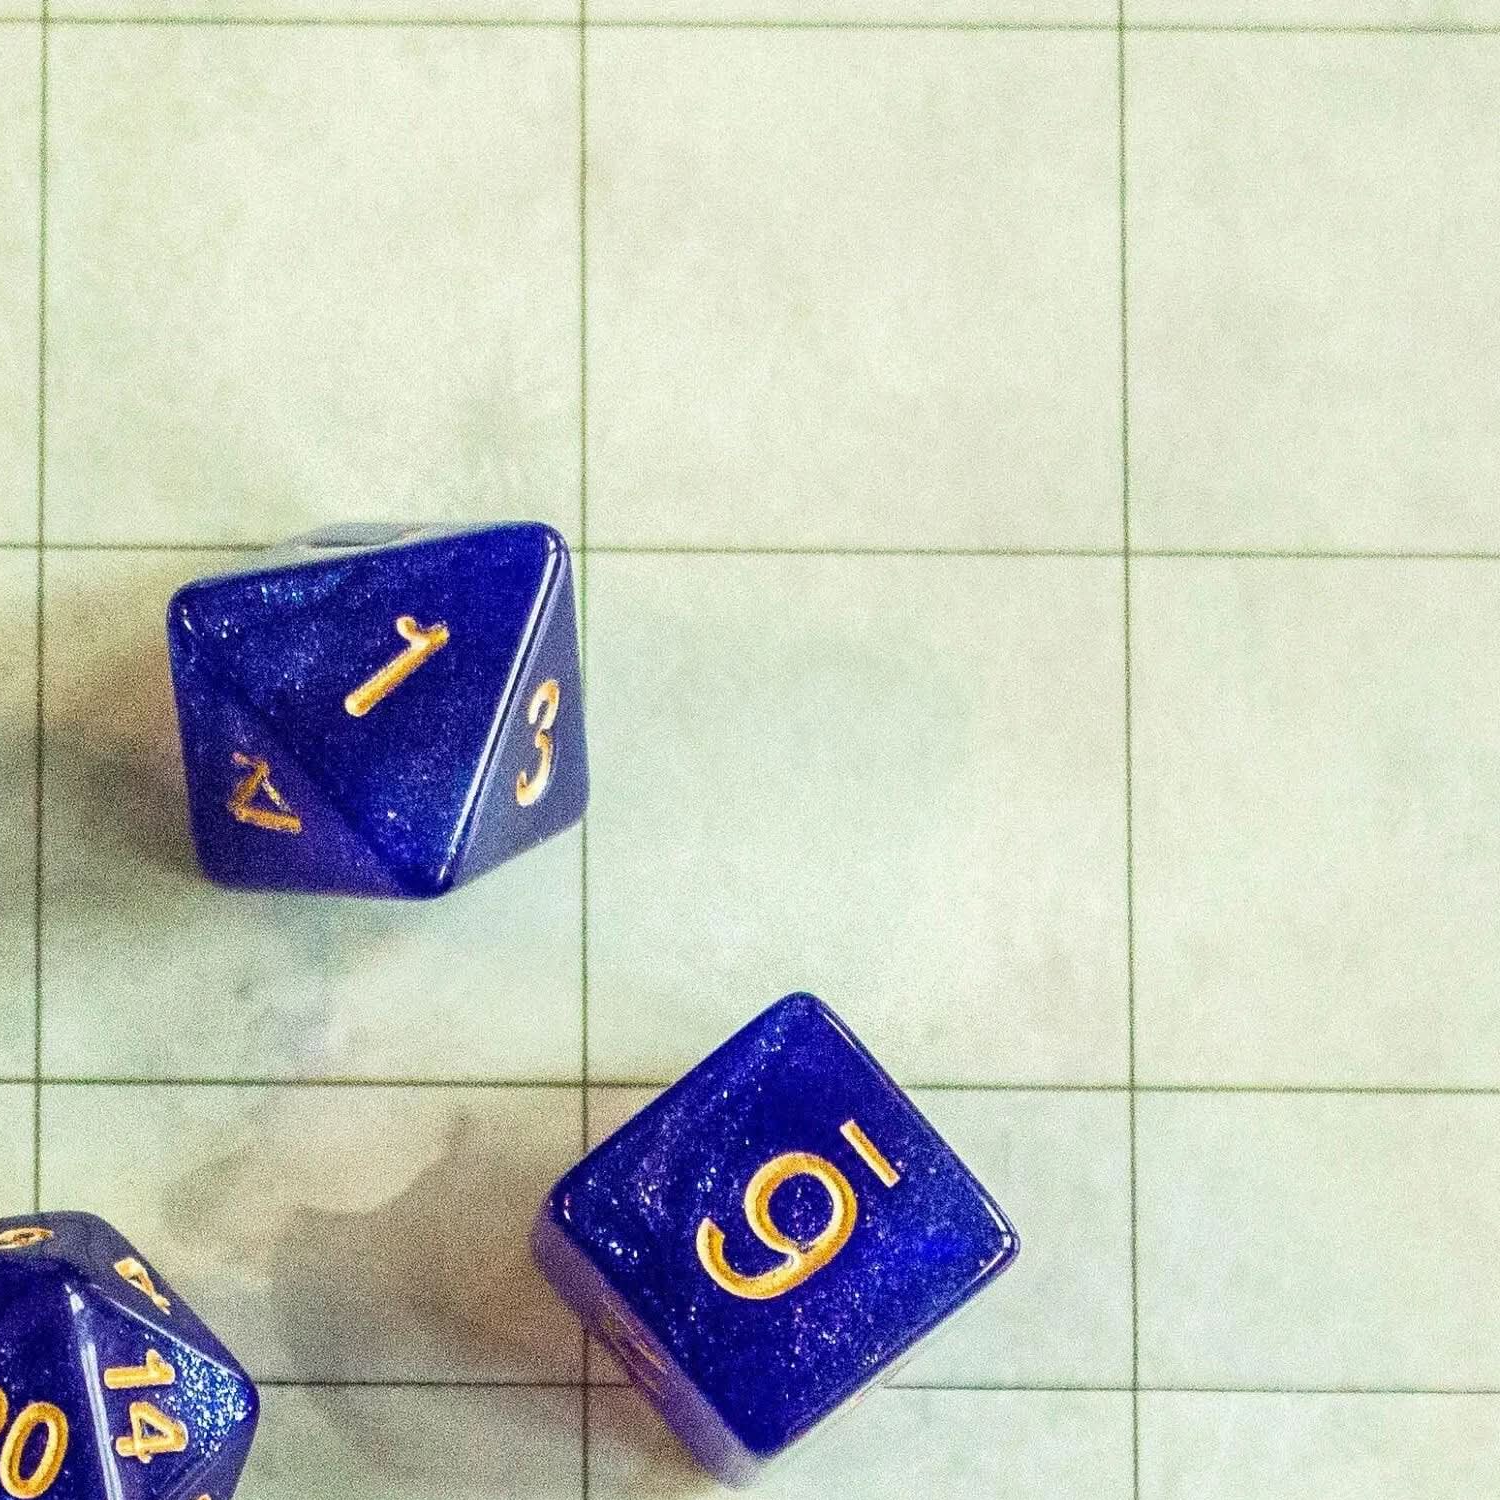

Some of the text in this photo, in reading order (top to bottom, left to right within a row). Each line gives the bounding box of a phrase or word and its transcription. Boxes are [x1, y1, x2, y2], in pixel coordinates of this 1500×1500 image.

[344, 616, 450, 717] 1
[227, 752, 302, 834] 4
[515, 678, 560, 807] 3
[104, 1350, 188, 1463] 14
